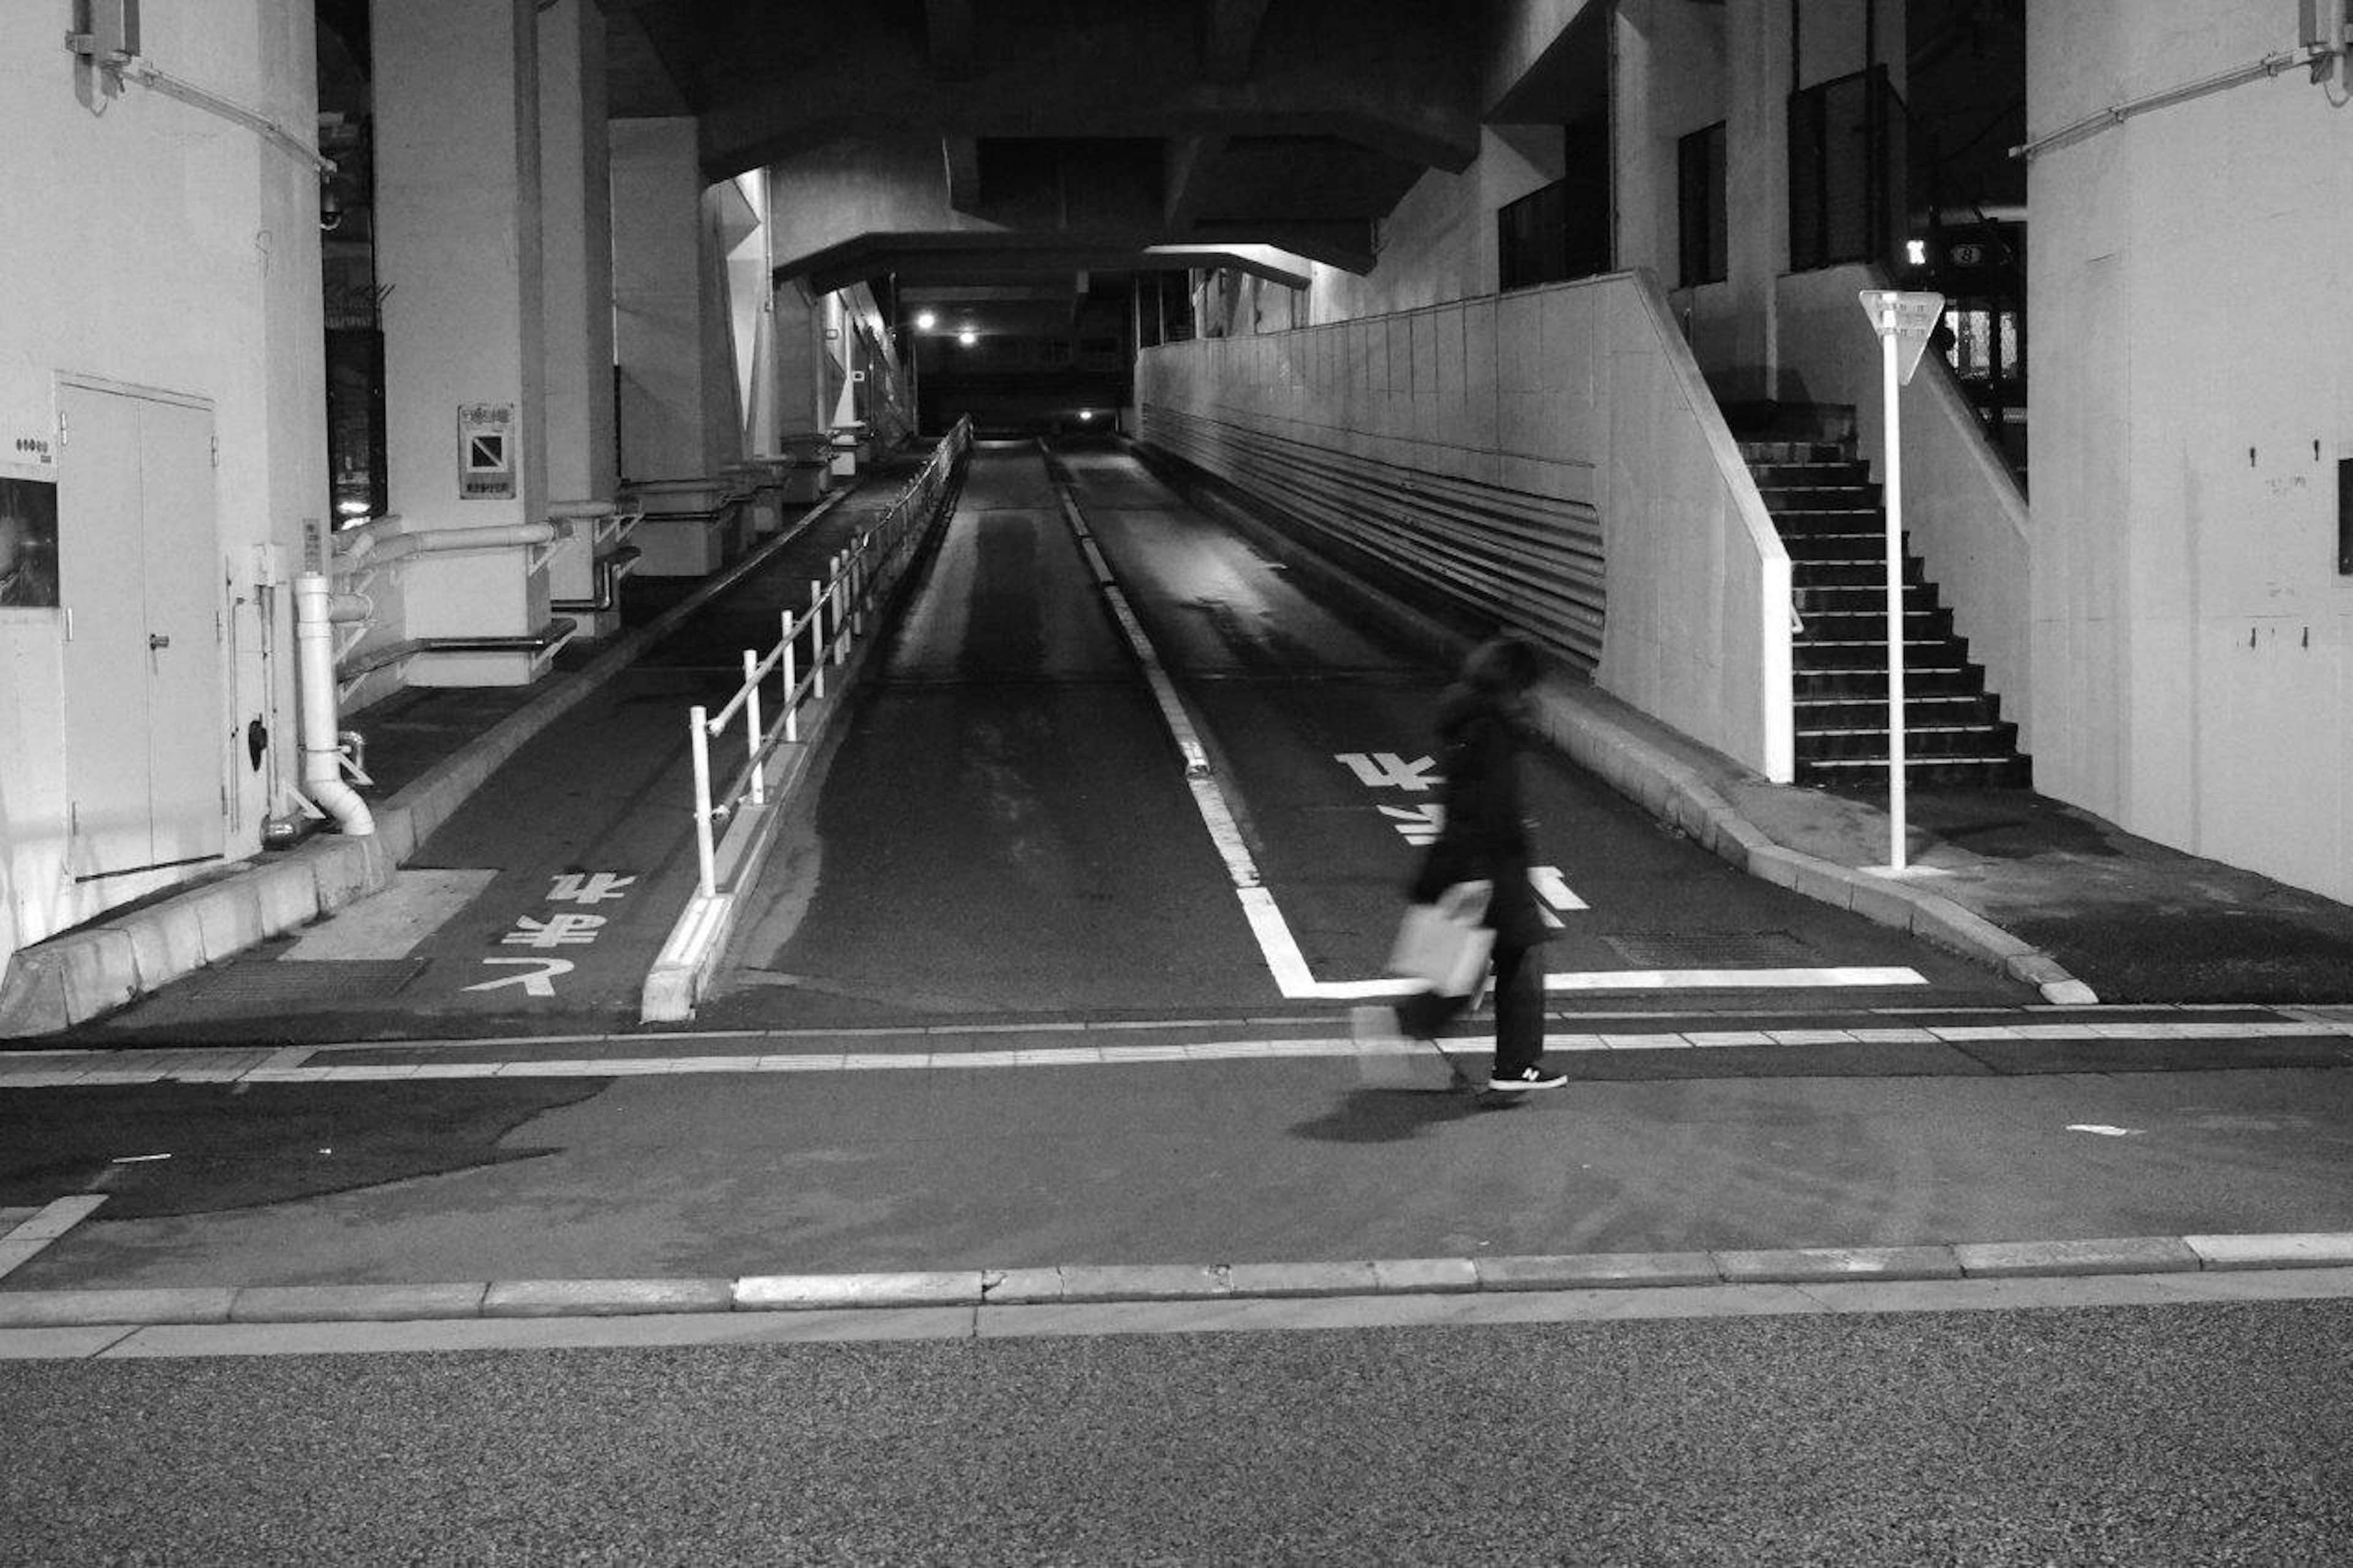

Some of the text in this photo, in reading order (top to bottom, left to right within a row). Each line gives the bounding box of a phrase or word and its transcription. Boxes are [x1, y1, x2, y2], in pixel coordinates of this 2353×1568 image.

[460, 873, 637, 996] とまれ
[1522, 1067, 1540, 1081] N
